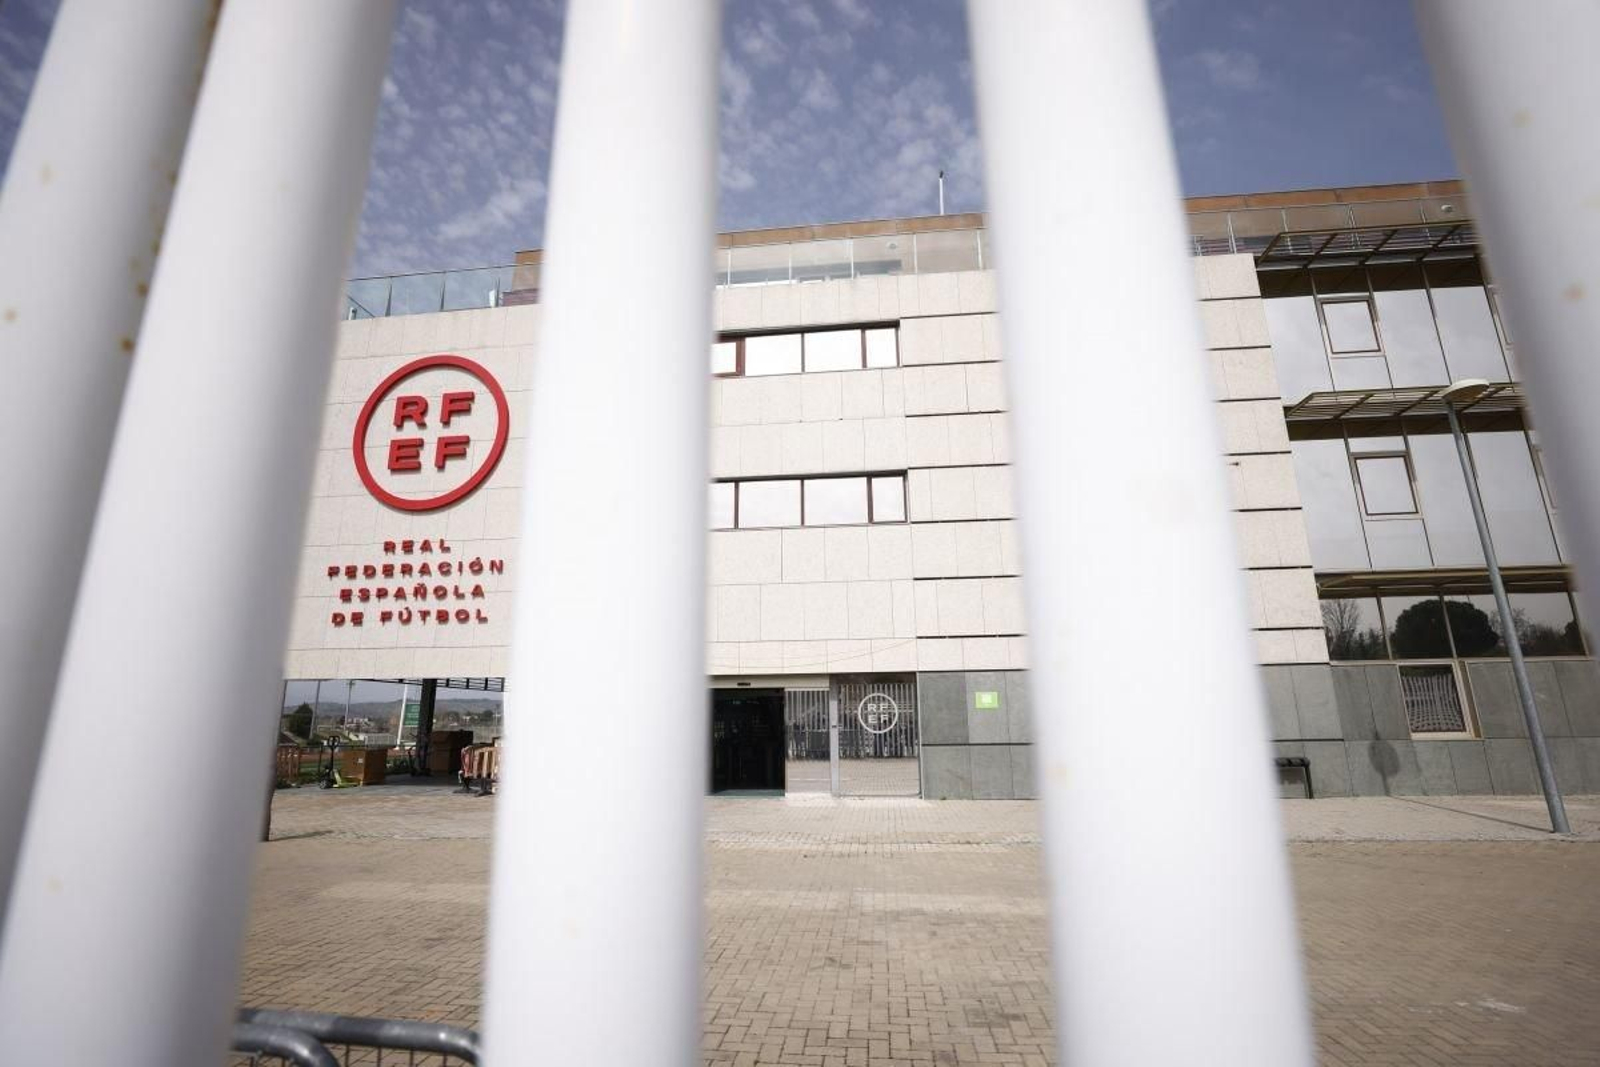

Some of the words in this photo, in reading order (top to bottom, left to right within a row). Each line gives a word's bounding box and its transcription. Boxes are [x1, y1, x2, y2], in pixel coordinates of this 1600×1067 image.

[393, 391, 475, 427] RF
[387, 435, 470, 472] EF
[383, 538, 451, 554] REAL
[327, 557, 505, 579] FEDERACIÓN
[339, 582, 485, 601] ESPAÑOLA
[331, 611, 364, 626] DE
[379, 606, 488, 624] FÚTBOL
